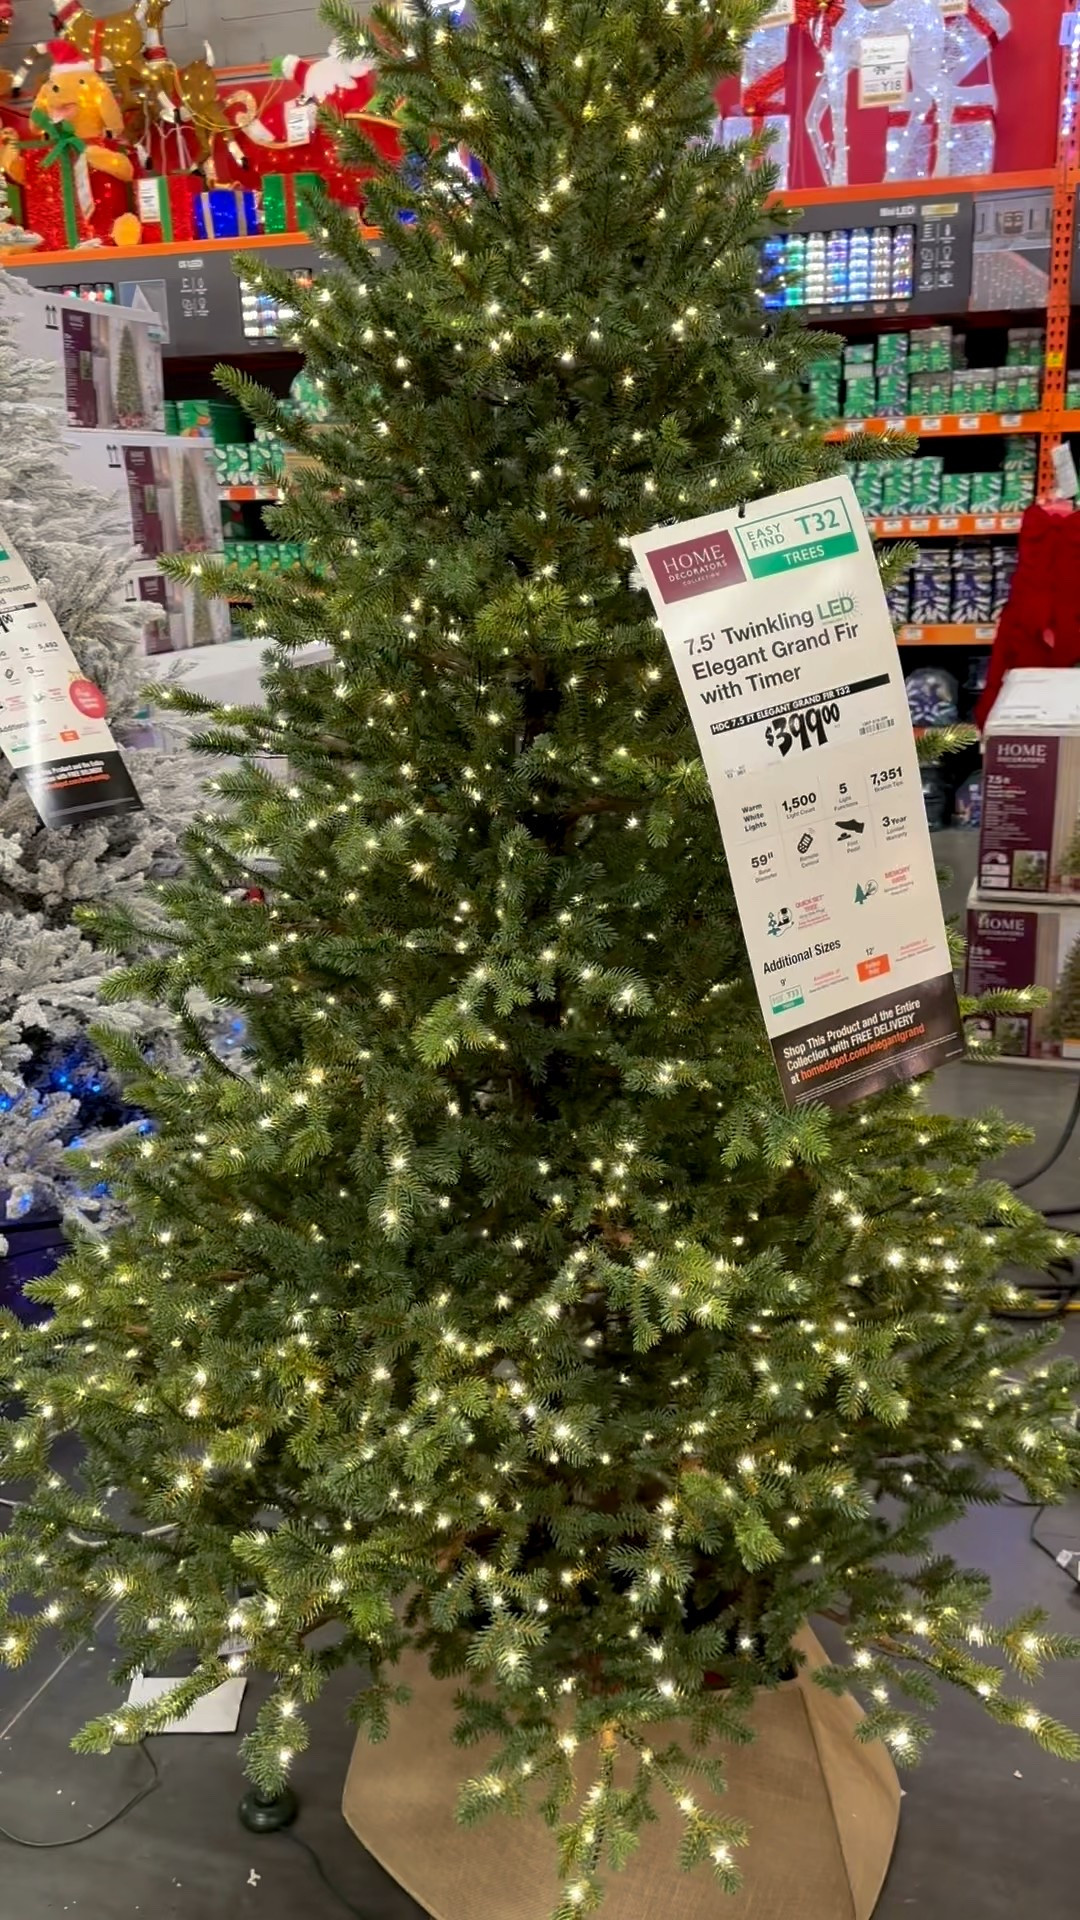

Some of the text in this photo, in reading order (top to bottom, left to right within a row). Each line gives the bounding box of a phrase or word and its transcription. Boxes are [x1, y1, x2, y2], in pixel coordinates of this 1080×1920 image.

[746, 522, 782, 541] EASY
[794, 509, 840, 535] T32
[751, 533, 785, 551] FIND
[662, 544, 725, 574] HOME
[782, 544, 825, 566] TREES
[668, 559, 728, 582] DECORATORS
[683, 596, 855, 656] 7.5' Twinkling LED
[692, 622, 859, 680] Elegant Grand Fir
[700, 666, 801, 705] with Timer
[712, 685, 851, 733] HDC 7.5 FT ELEGANT GRAND FIR T32
[997, 743, 1048, 757] HOME
[870, 766, 902, 786] 7,351
[839, 782, 848, 794] 5
[741, 803, 763, 814] Warm
[781, 792, 817, 813] 1,500
[743, 812, 765, 823] White
[786, 811, 800, 820] Light
[882, 815, 907, 827] 3 Year
[744, 820, 767, 832] Lights
[751, 851, 774, 869] 59"
[762, 939, 842, 975] Additional Sizes
[783, 999, 921, 1060] Shop This Product and the Entire
[786, 1013, 914, 1072] Collection with FREE DELIVERY
[790, 1073, 800, 1085] at
